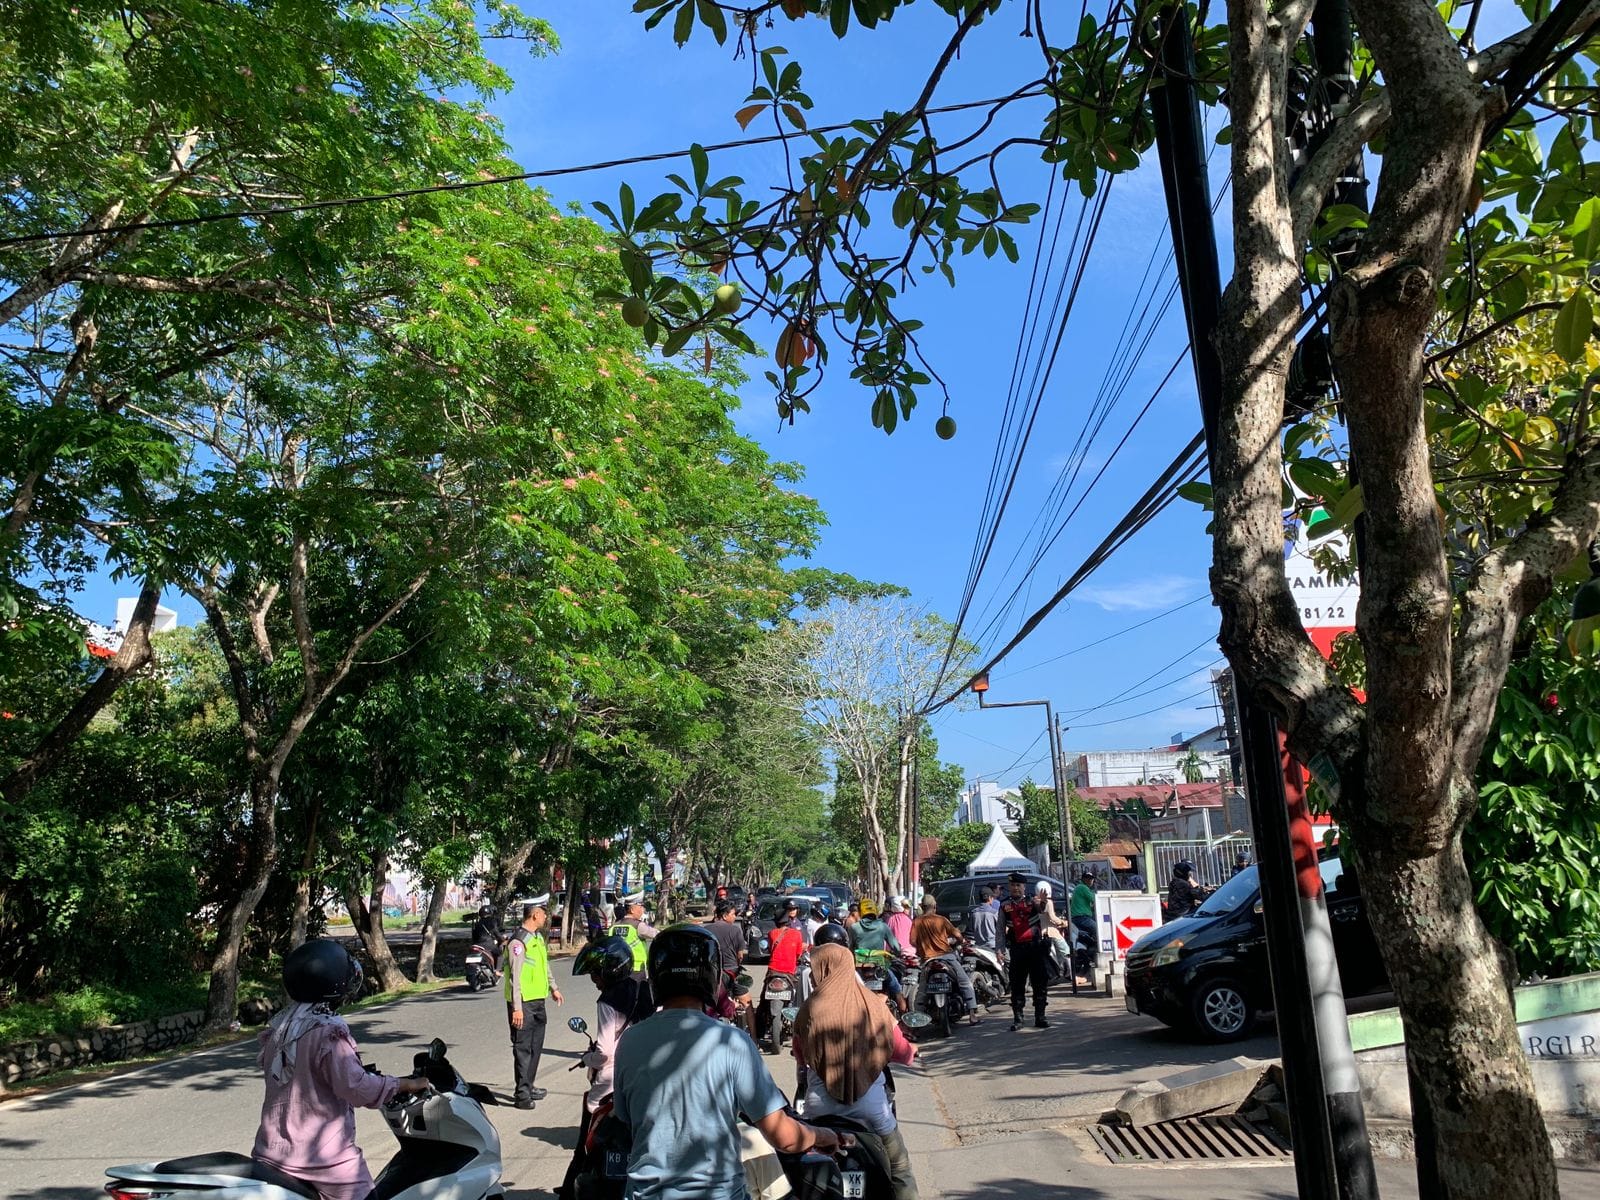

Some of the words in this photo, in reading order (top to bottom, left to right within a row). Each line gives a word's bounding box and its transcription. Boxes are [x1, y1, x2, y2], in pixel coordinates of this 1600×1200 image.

[1327, 606, 1345, 618] 22
[1581, 1035, 1599, 1056] R
[849, 1173, 862, 1185] XK
